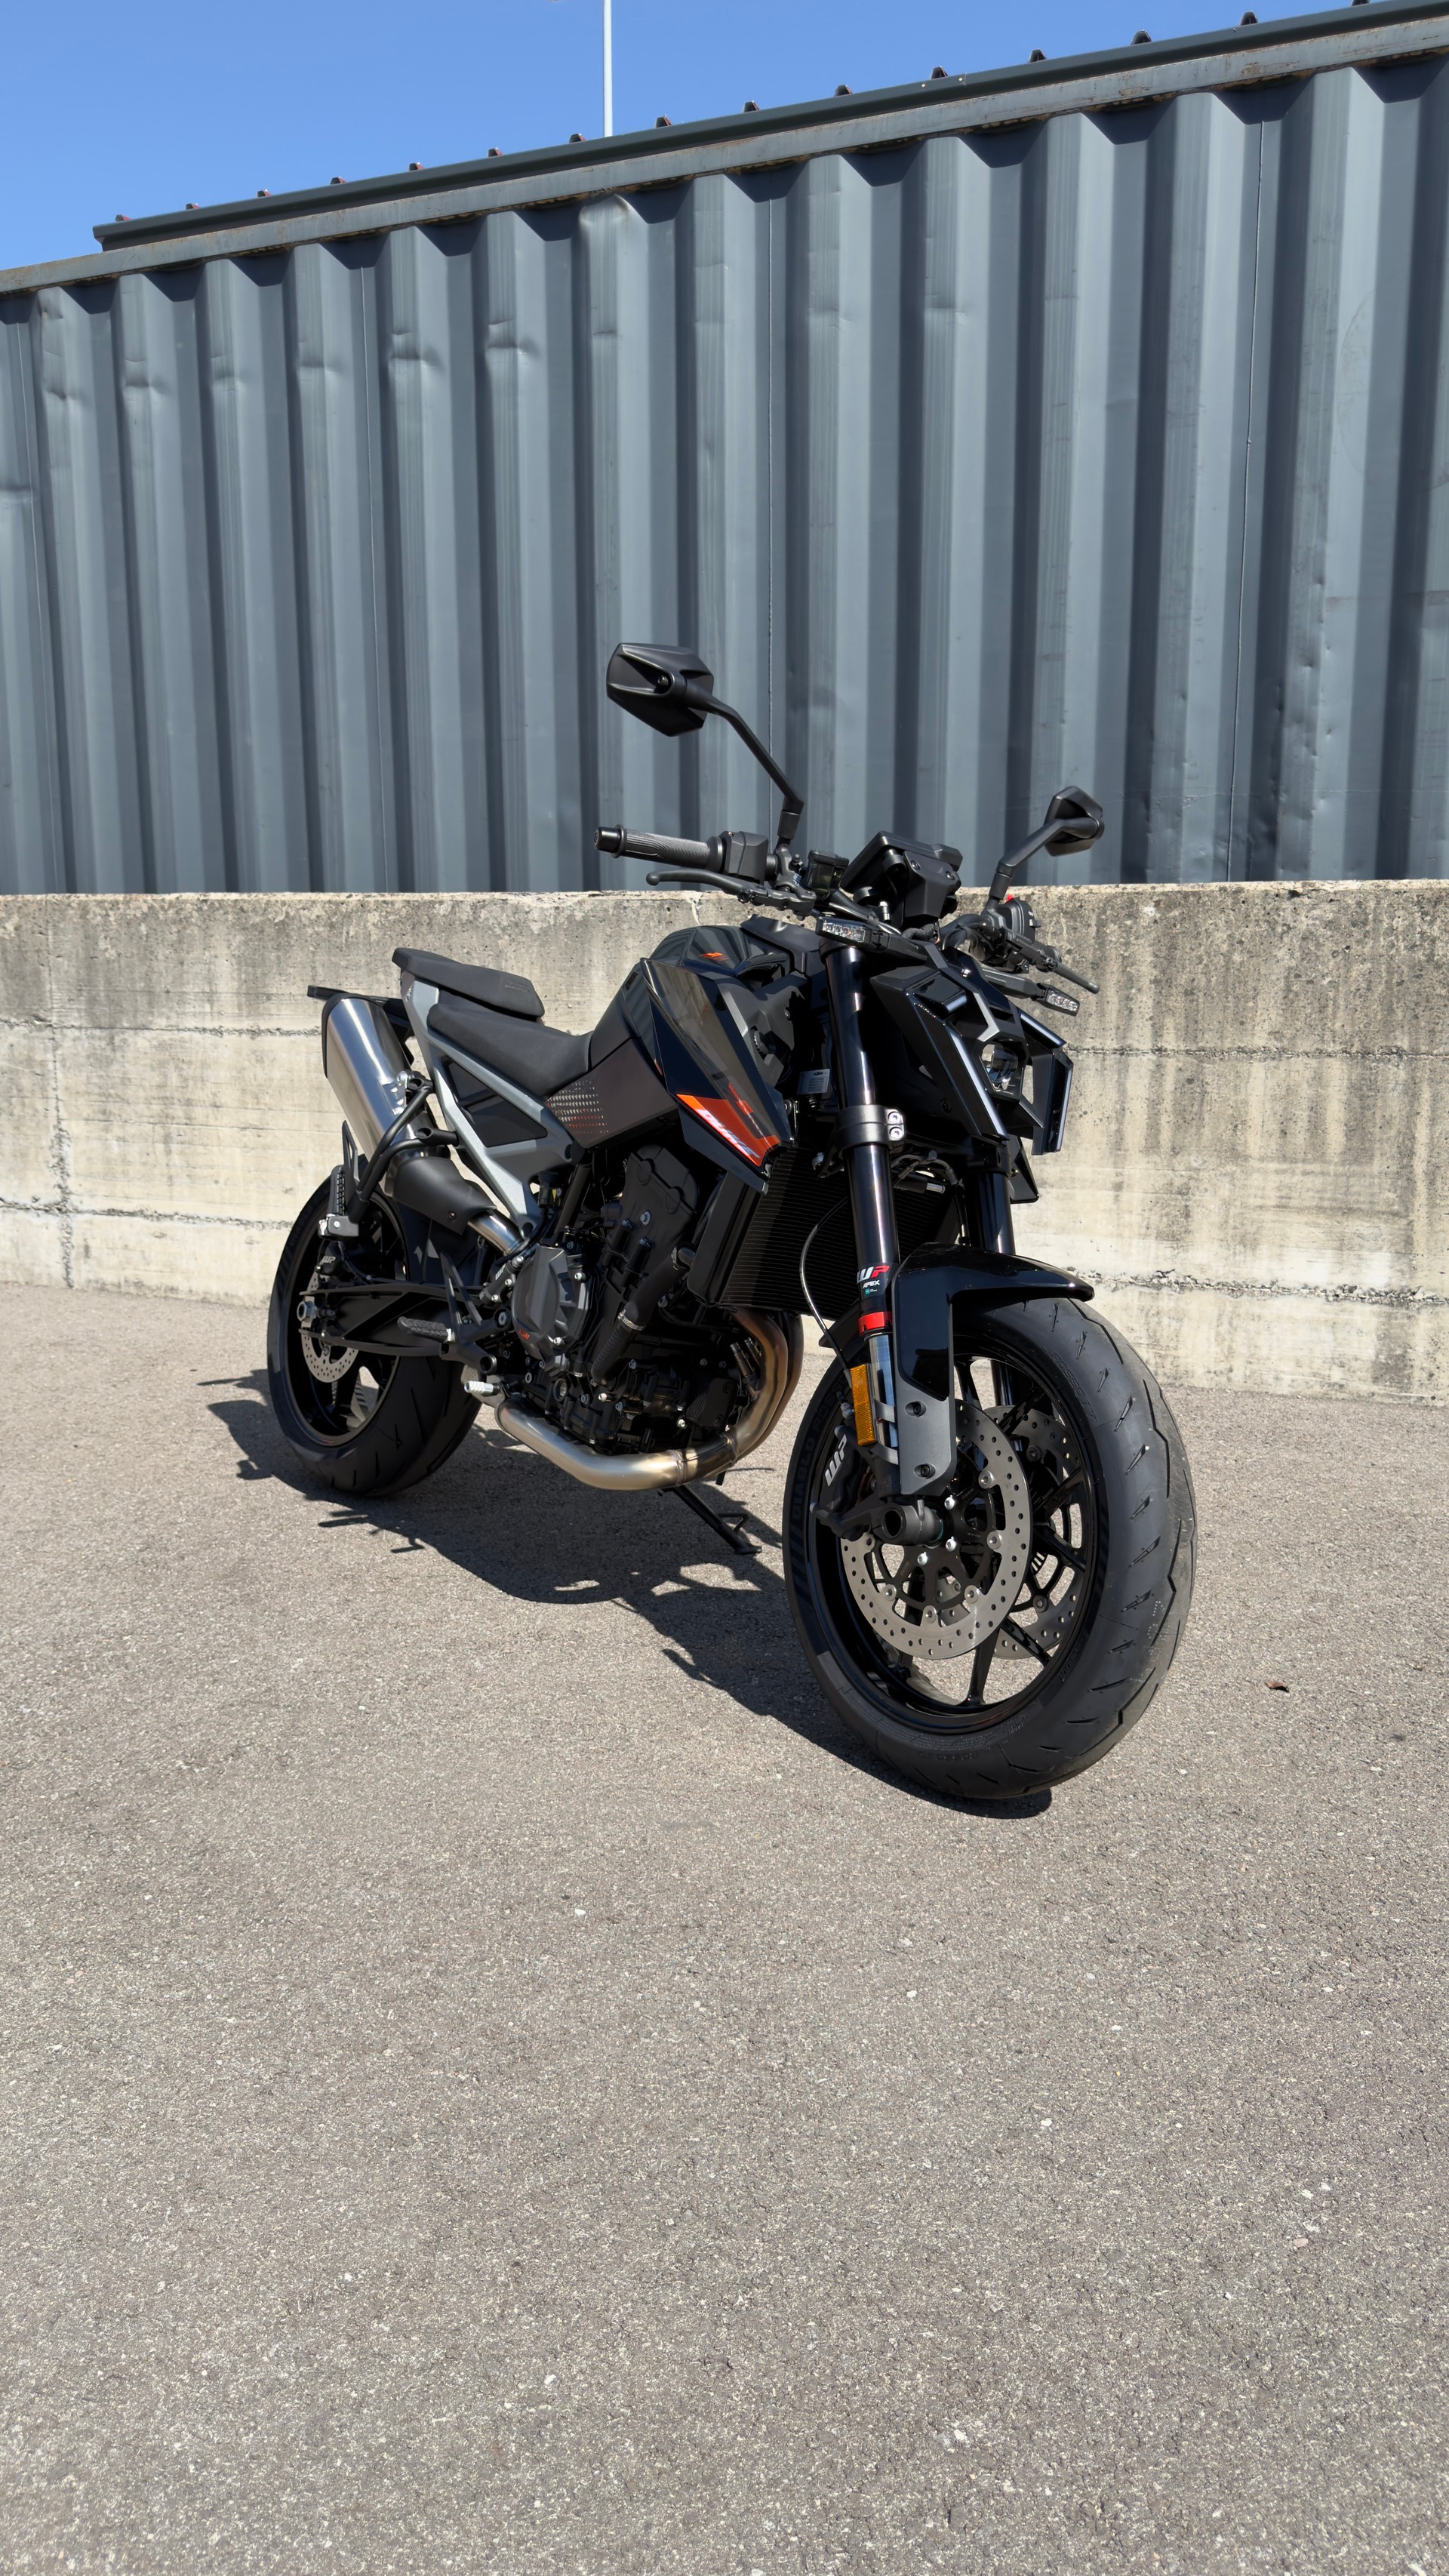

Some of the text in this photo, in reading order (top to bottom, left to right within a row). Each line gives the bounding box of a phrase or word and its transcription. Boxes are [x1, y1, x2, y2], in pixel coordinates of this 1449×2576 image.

[694, 1109, 761, 1159] DUKE
[857, 1266, 890, 1284] WP
[863, 1280, 880, 1288] APEX
[792, 1437, 816, 1520] DIABLO
[825, 1434, 847, 1486] WP
